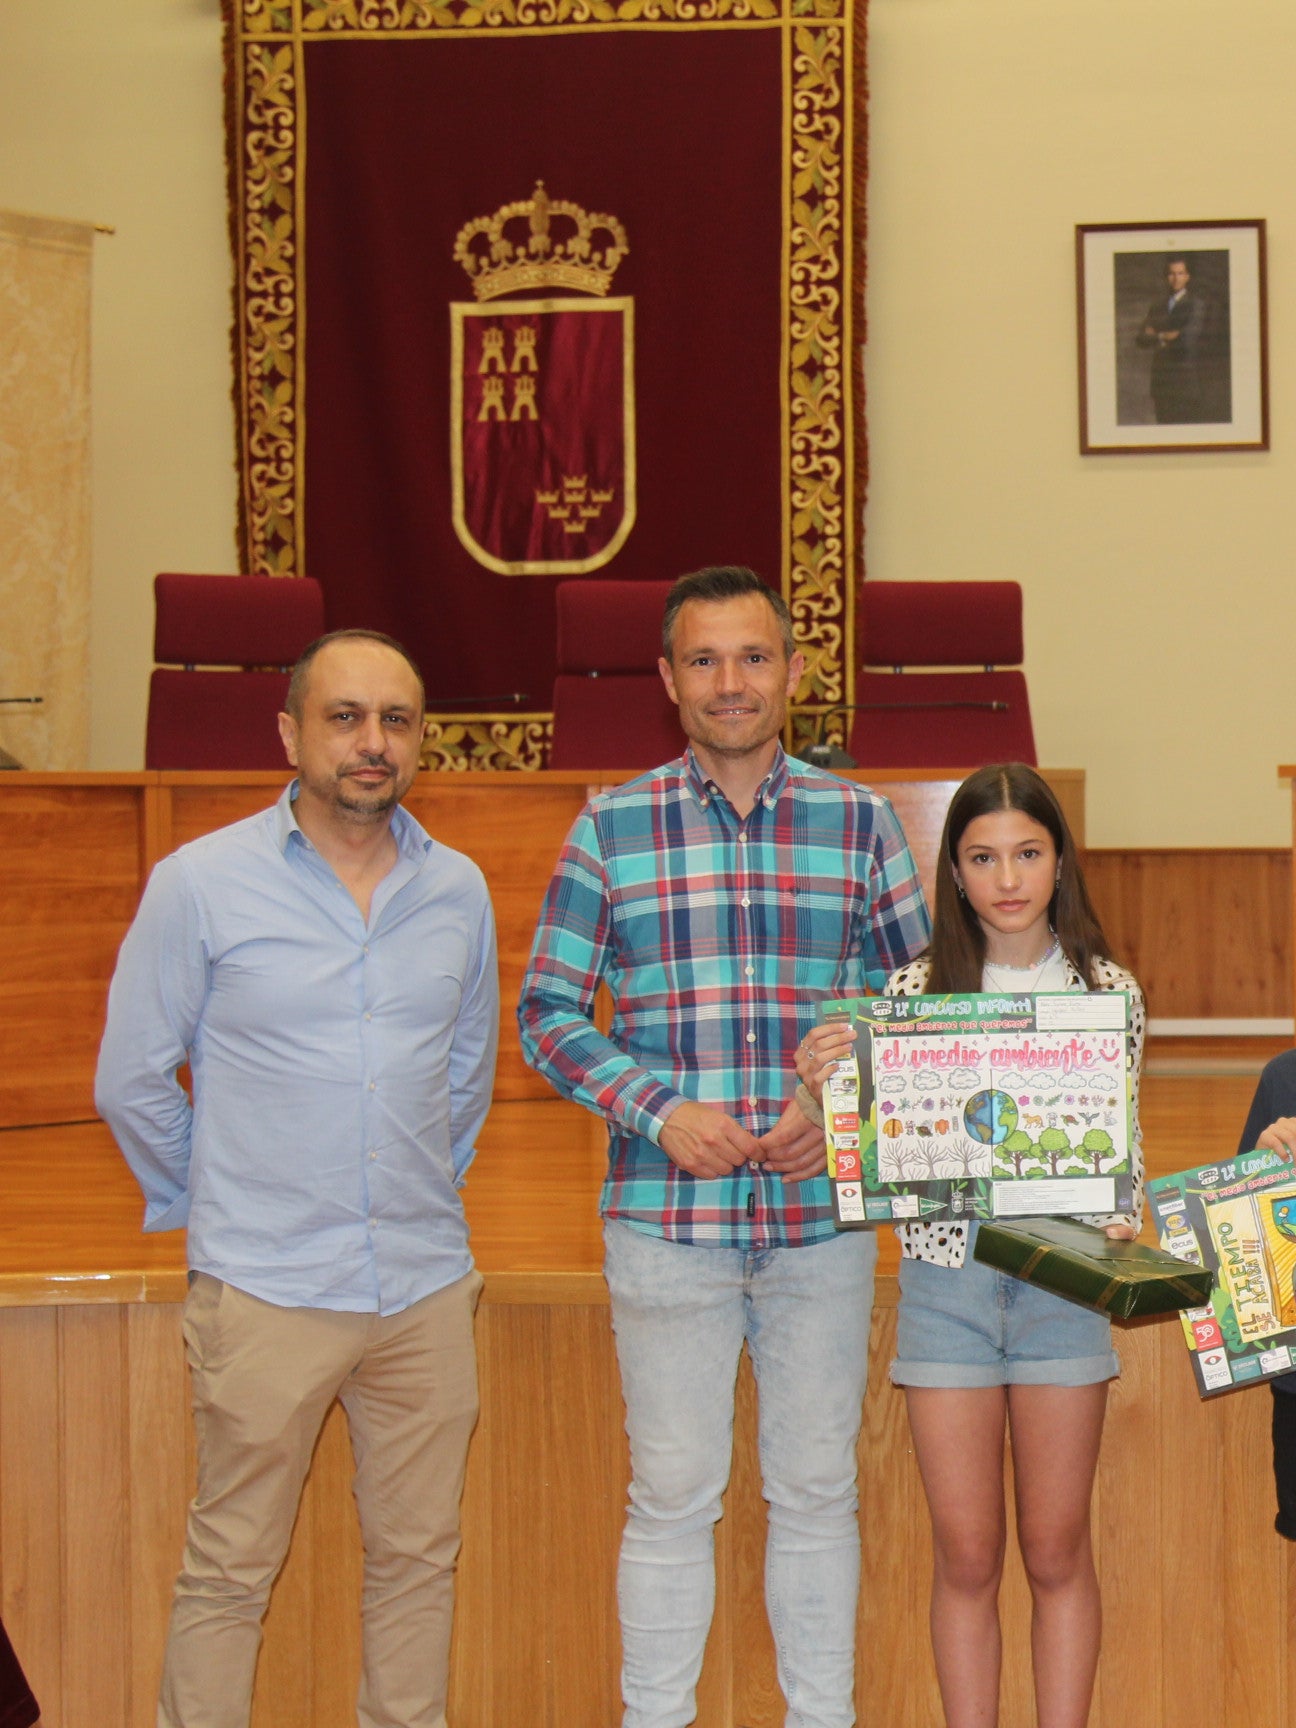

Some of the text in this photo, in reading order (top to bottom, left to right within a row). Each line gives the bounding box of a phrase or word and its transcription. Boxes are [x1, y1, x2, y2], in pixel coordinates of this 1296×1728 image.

[960, 1020, 977, 1030] que
[881, 1040, 905, 1068] el
[909, 1041, 986, 1069] medio
[1171, 1238, 1194, 1248] ecus
[1217, 1222, 1251, 1312] TIEMPO
[1245, 1259, 1269, 1304] ACABA
[1242, 1314, 1259, 1335] EL
[1255, 1312, 1276, 1331] SE
